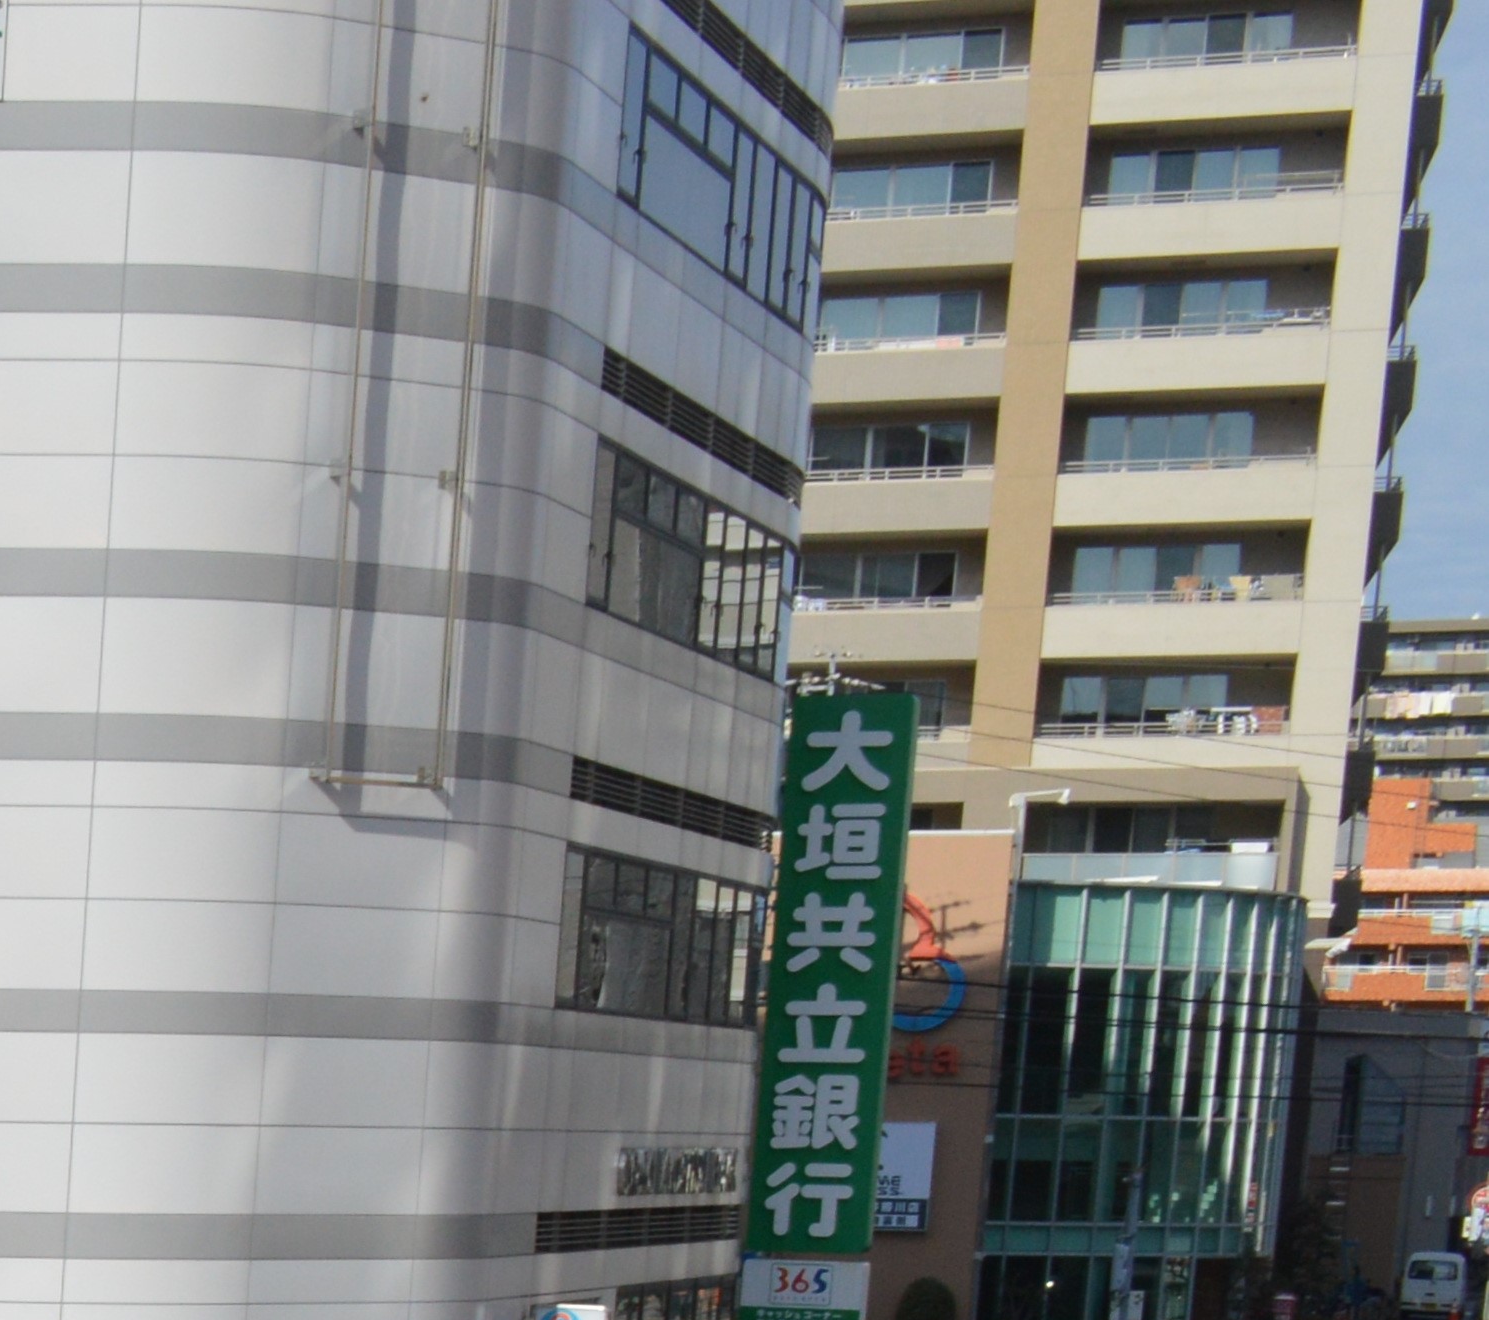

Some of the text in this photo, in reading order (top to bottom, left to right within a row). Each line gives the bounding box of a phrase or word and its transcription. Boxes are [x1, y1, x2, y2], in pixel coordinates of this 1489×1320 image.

[767, 710, 894, 1237] 大垣共立銀行
[773, 1267, 830, 1294] 365
[755, 1308, 842, 1320] キャッシュコーナー
